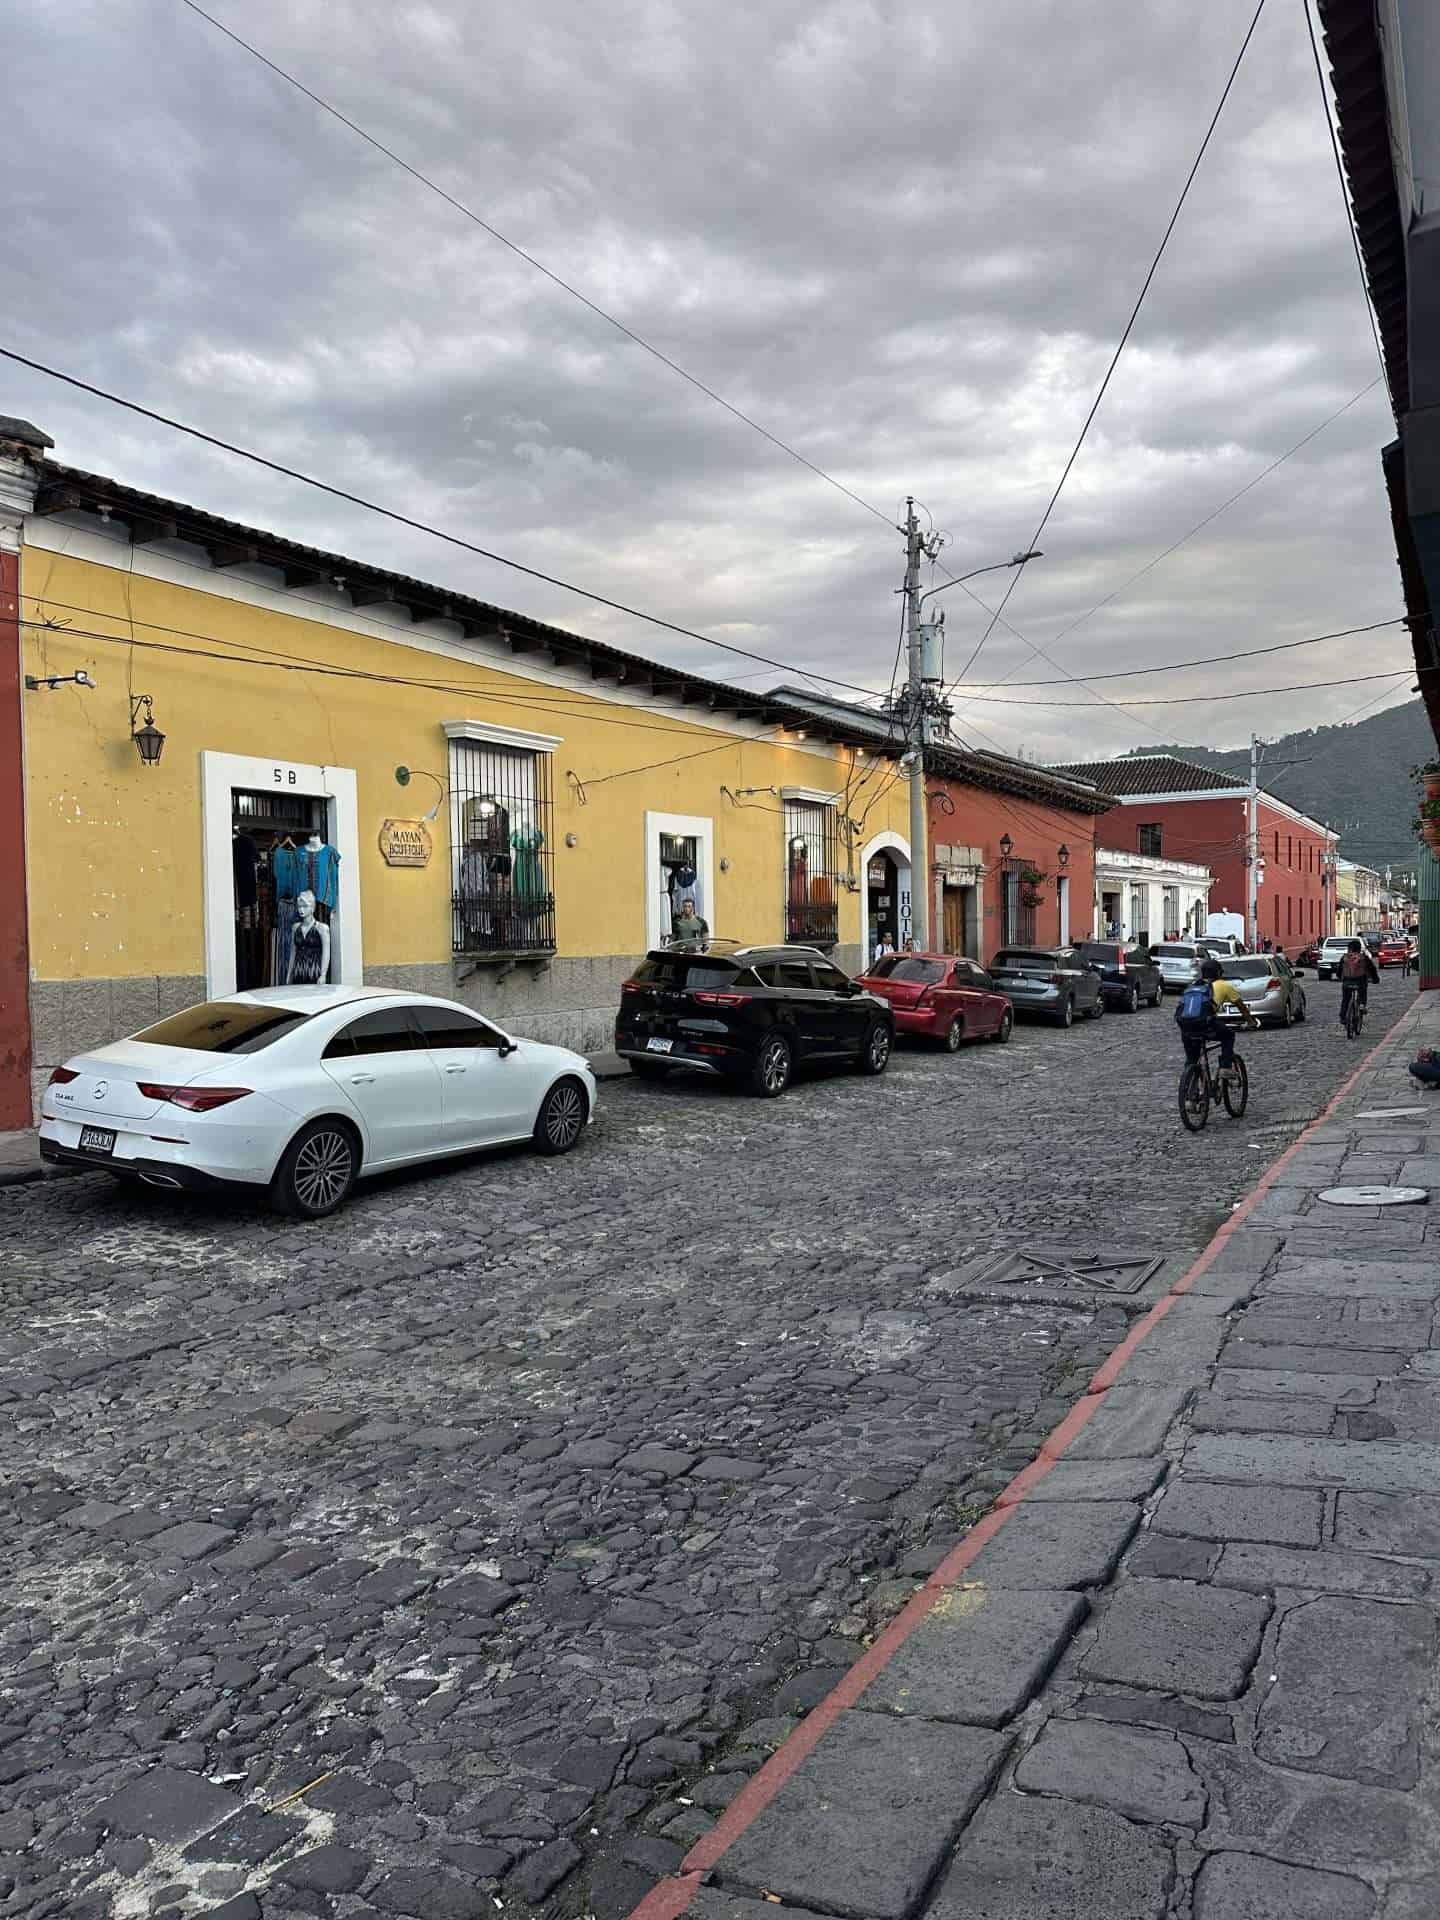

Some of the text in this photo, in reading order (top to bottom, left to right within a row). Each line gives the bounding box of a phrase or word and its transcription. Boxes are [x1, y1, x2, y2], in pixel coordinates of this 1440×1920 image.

[273, 768, 297, 785] 5 B
[392, 831, 422, 842] MAYAN
[389, 843, 426, 856] BOUTIQUE
